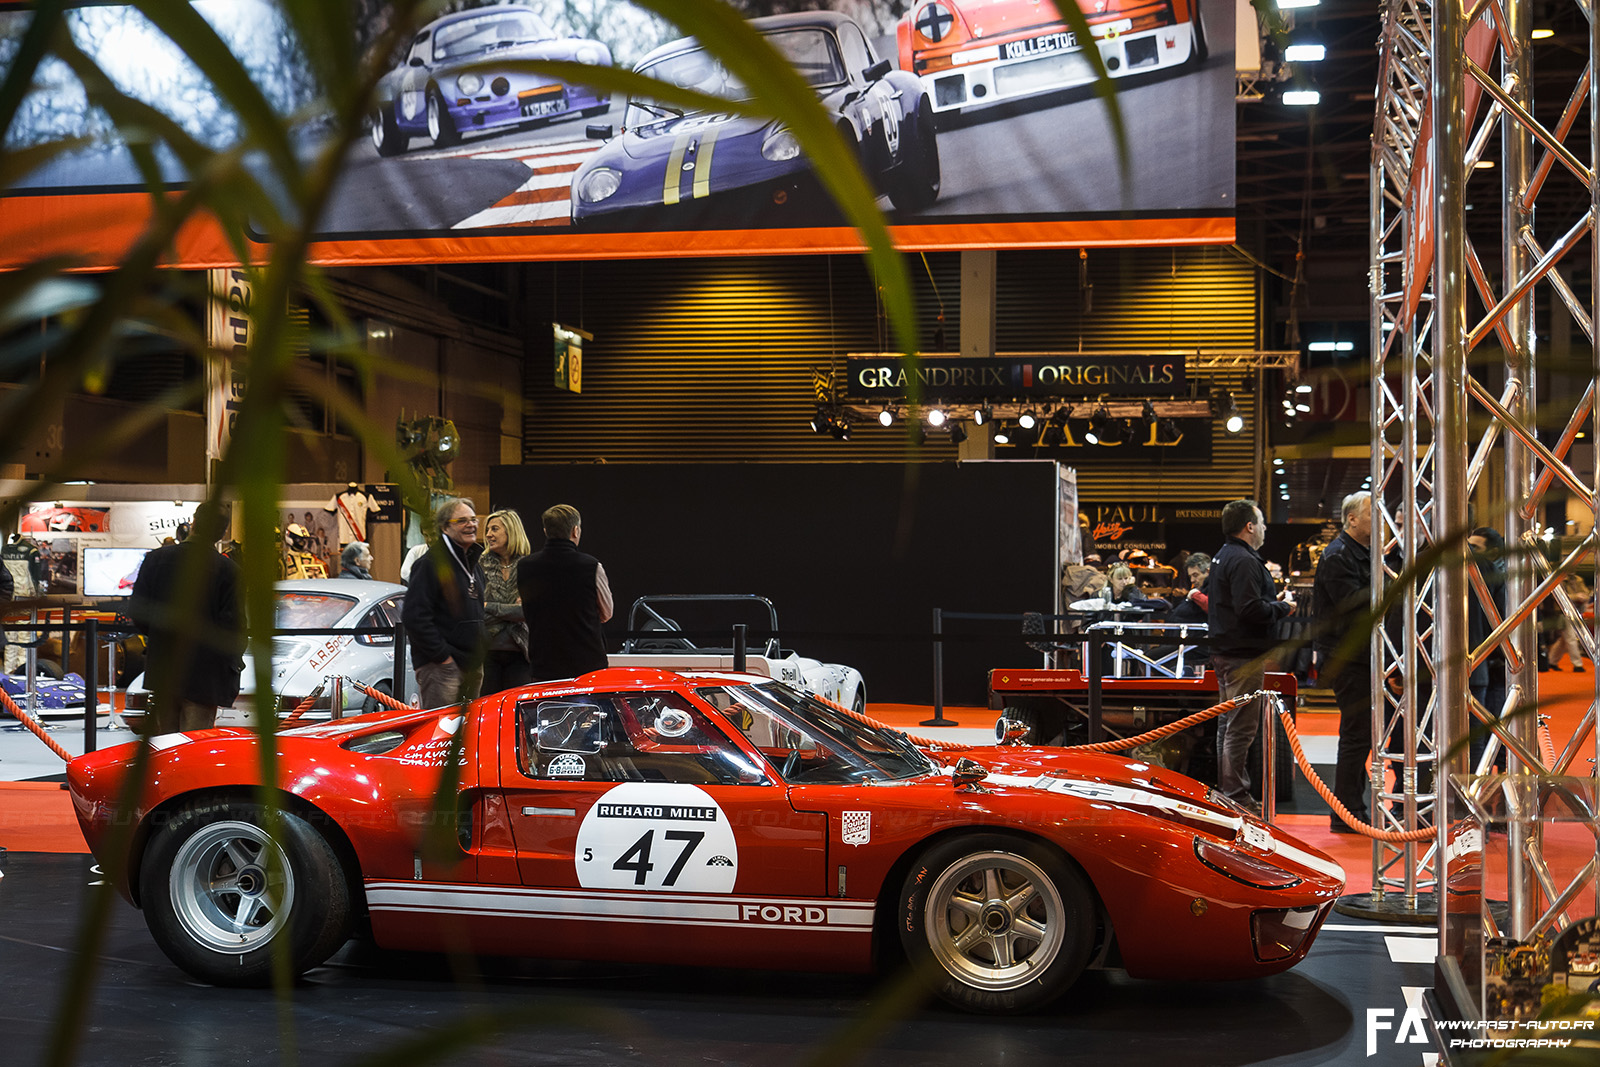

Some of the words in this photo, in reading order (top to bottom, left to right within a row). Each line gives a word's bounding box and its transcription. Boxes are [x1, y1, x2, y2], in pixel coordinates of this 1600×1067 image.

[858, 366, 1006, 388] GRANDPRIX
[1038, 363, 1175, 385] ORIGINALS
[1097, 505, 1165, 523] PAUL
[782, 668, 796, 681] Shell
[600, 805, 663, 817] RICHARD
[670, 808, 714, 819] MILLE
[583, 848, 593, 862] 5
[612, 829, 705, 887] 47
[742, 905, 826, 925] FORD
